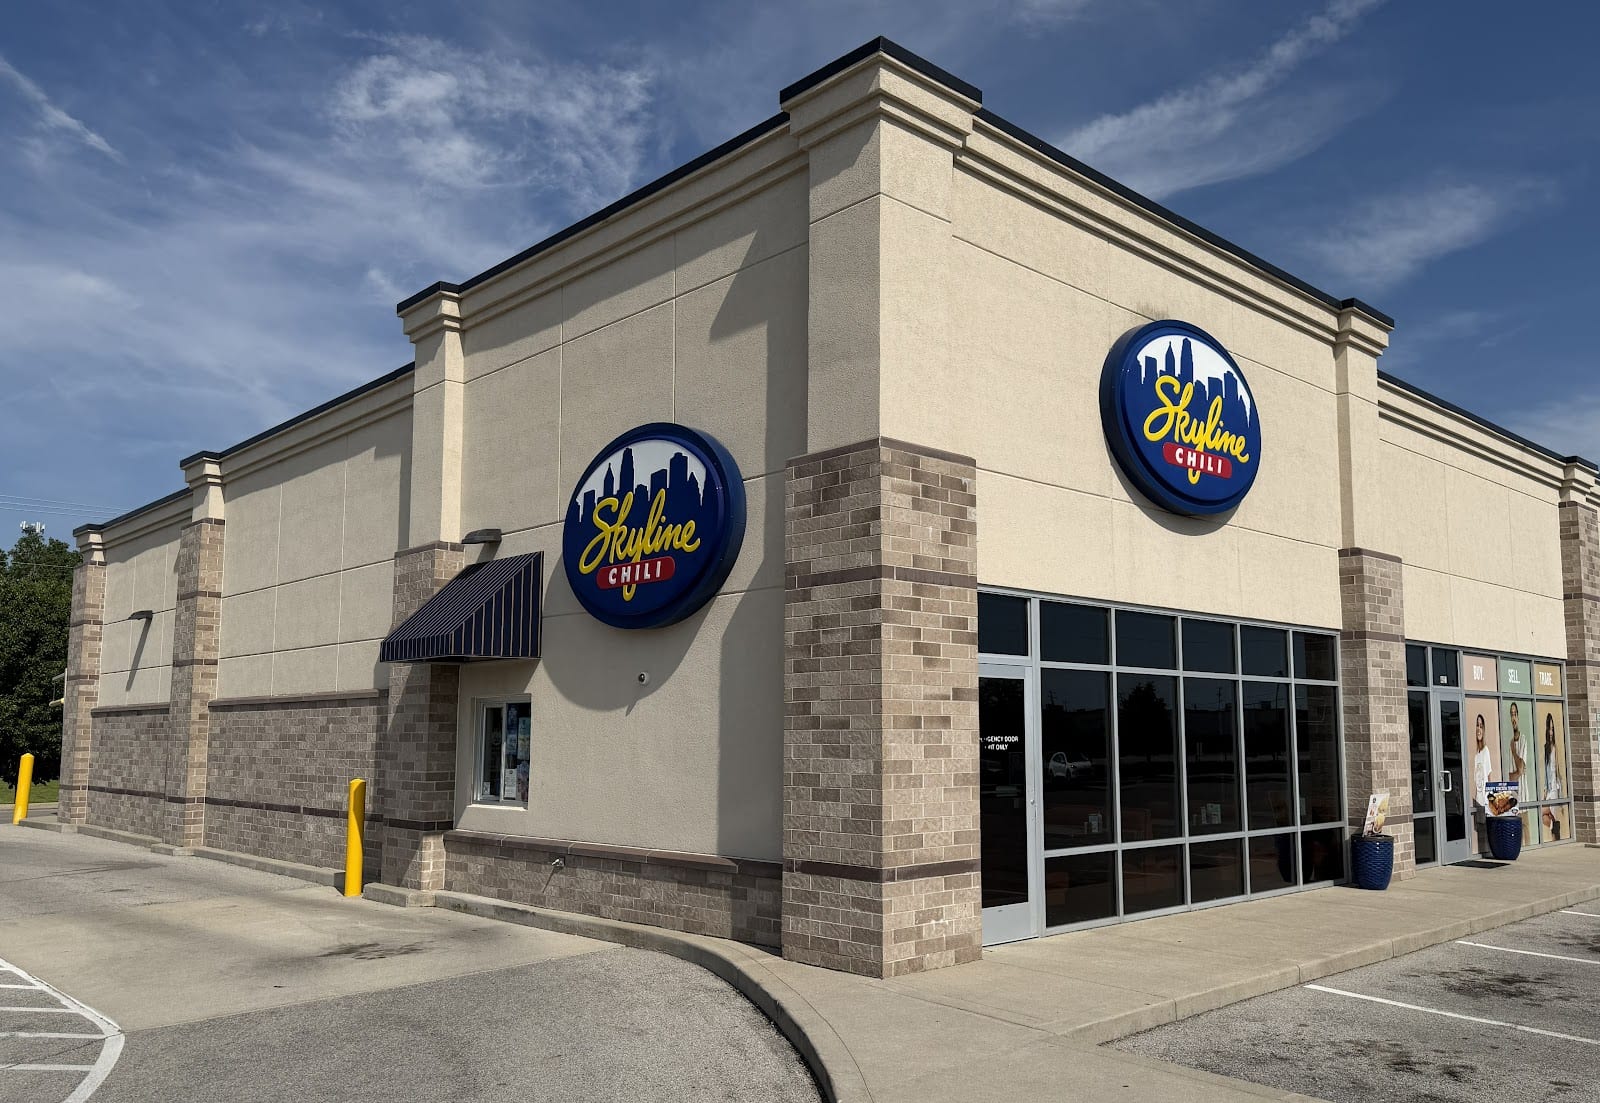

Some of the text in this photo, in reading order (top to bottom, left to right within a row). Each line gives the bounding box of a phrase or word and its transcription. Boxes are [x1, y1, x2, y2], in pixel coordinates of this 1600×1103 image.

[1143, 375, 1249, 485] Skyline
[1175, 447, 1223, 474] CHILI
[579, 487, 701, 602] Skyline
[608, 560, 662, 585] CHILI
